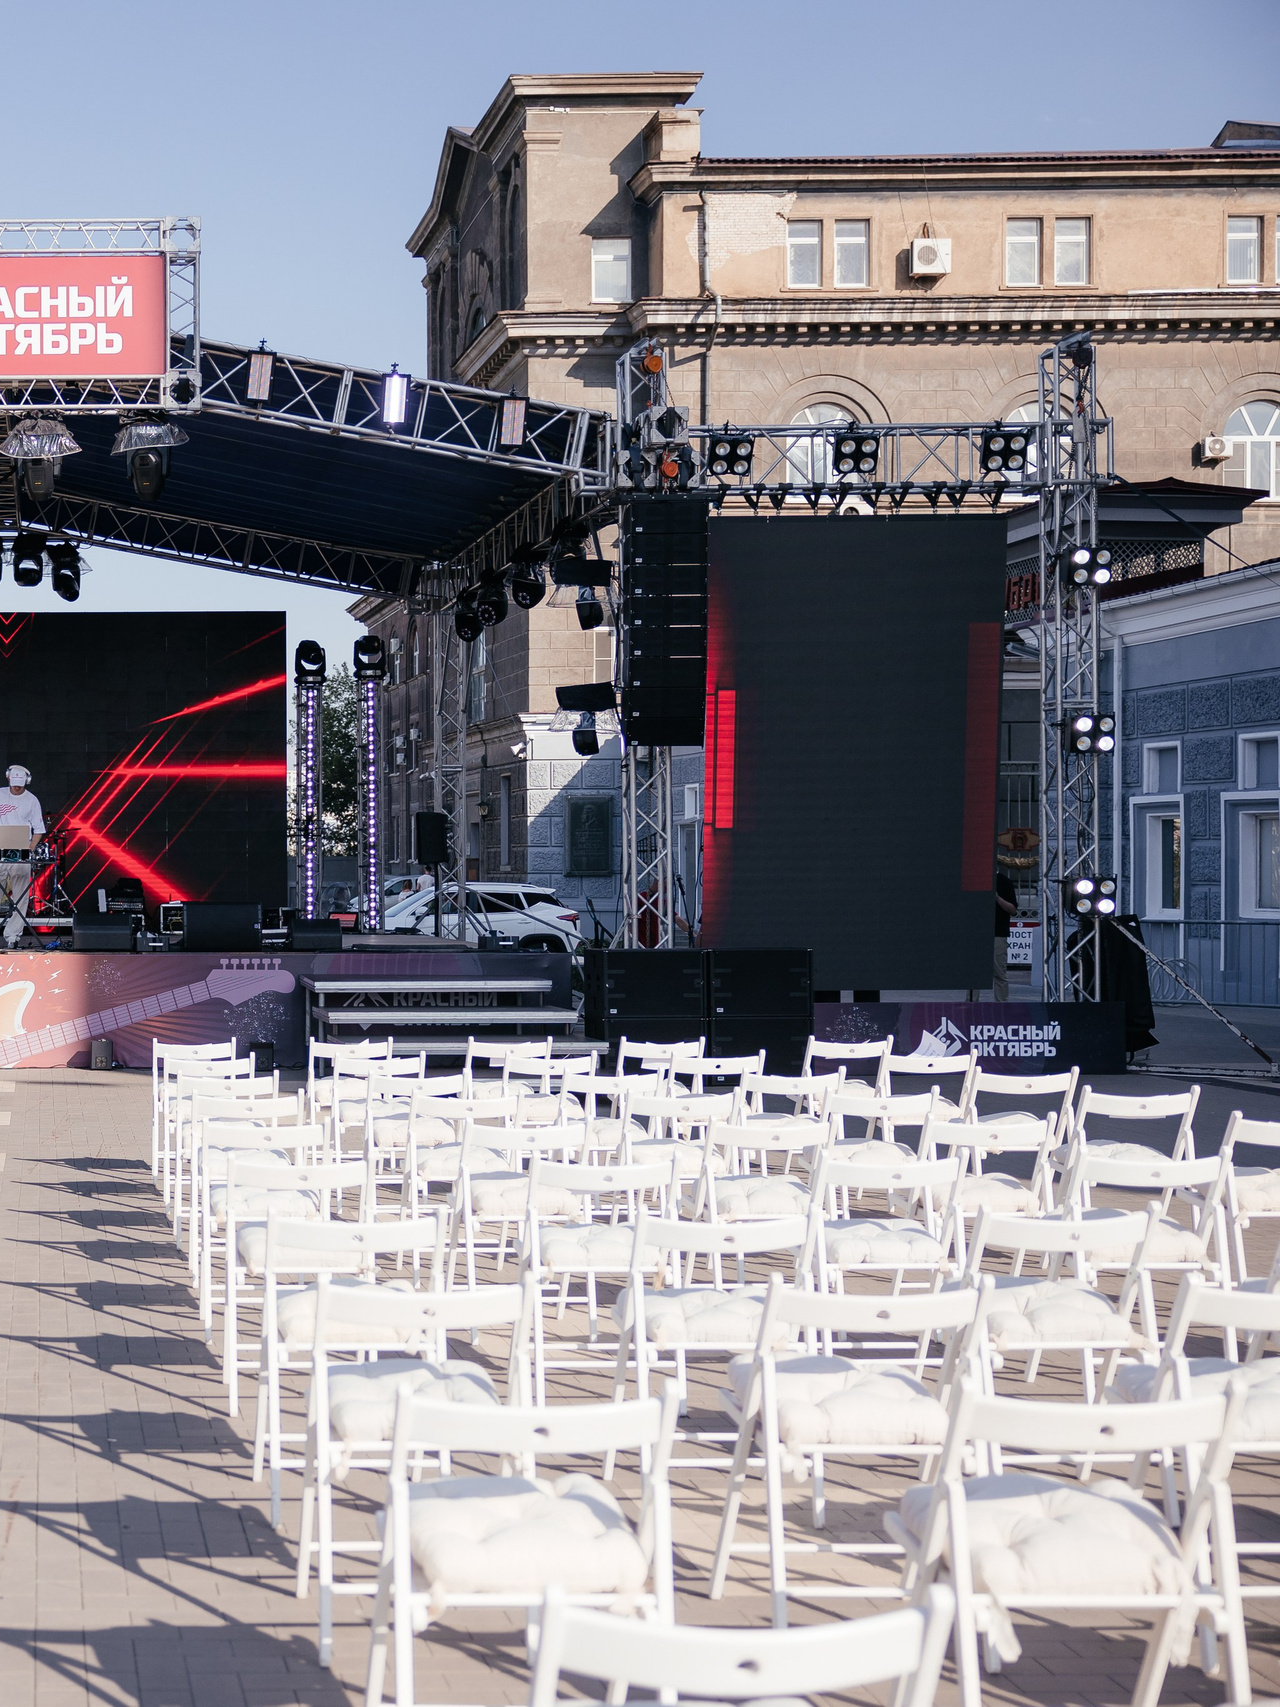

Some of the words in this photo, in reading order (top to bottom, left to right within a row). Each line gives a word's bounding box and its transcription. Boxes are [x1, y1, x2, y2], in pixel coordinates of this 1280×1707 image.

[1007, 942, 1033, 950] ХРАН
[970, 1021, 1061, 1041] КРАСНЫЙ
[970, 1042, 1057, 1057] ОКТЯБРЬ
